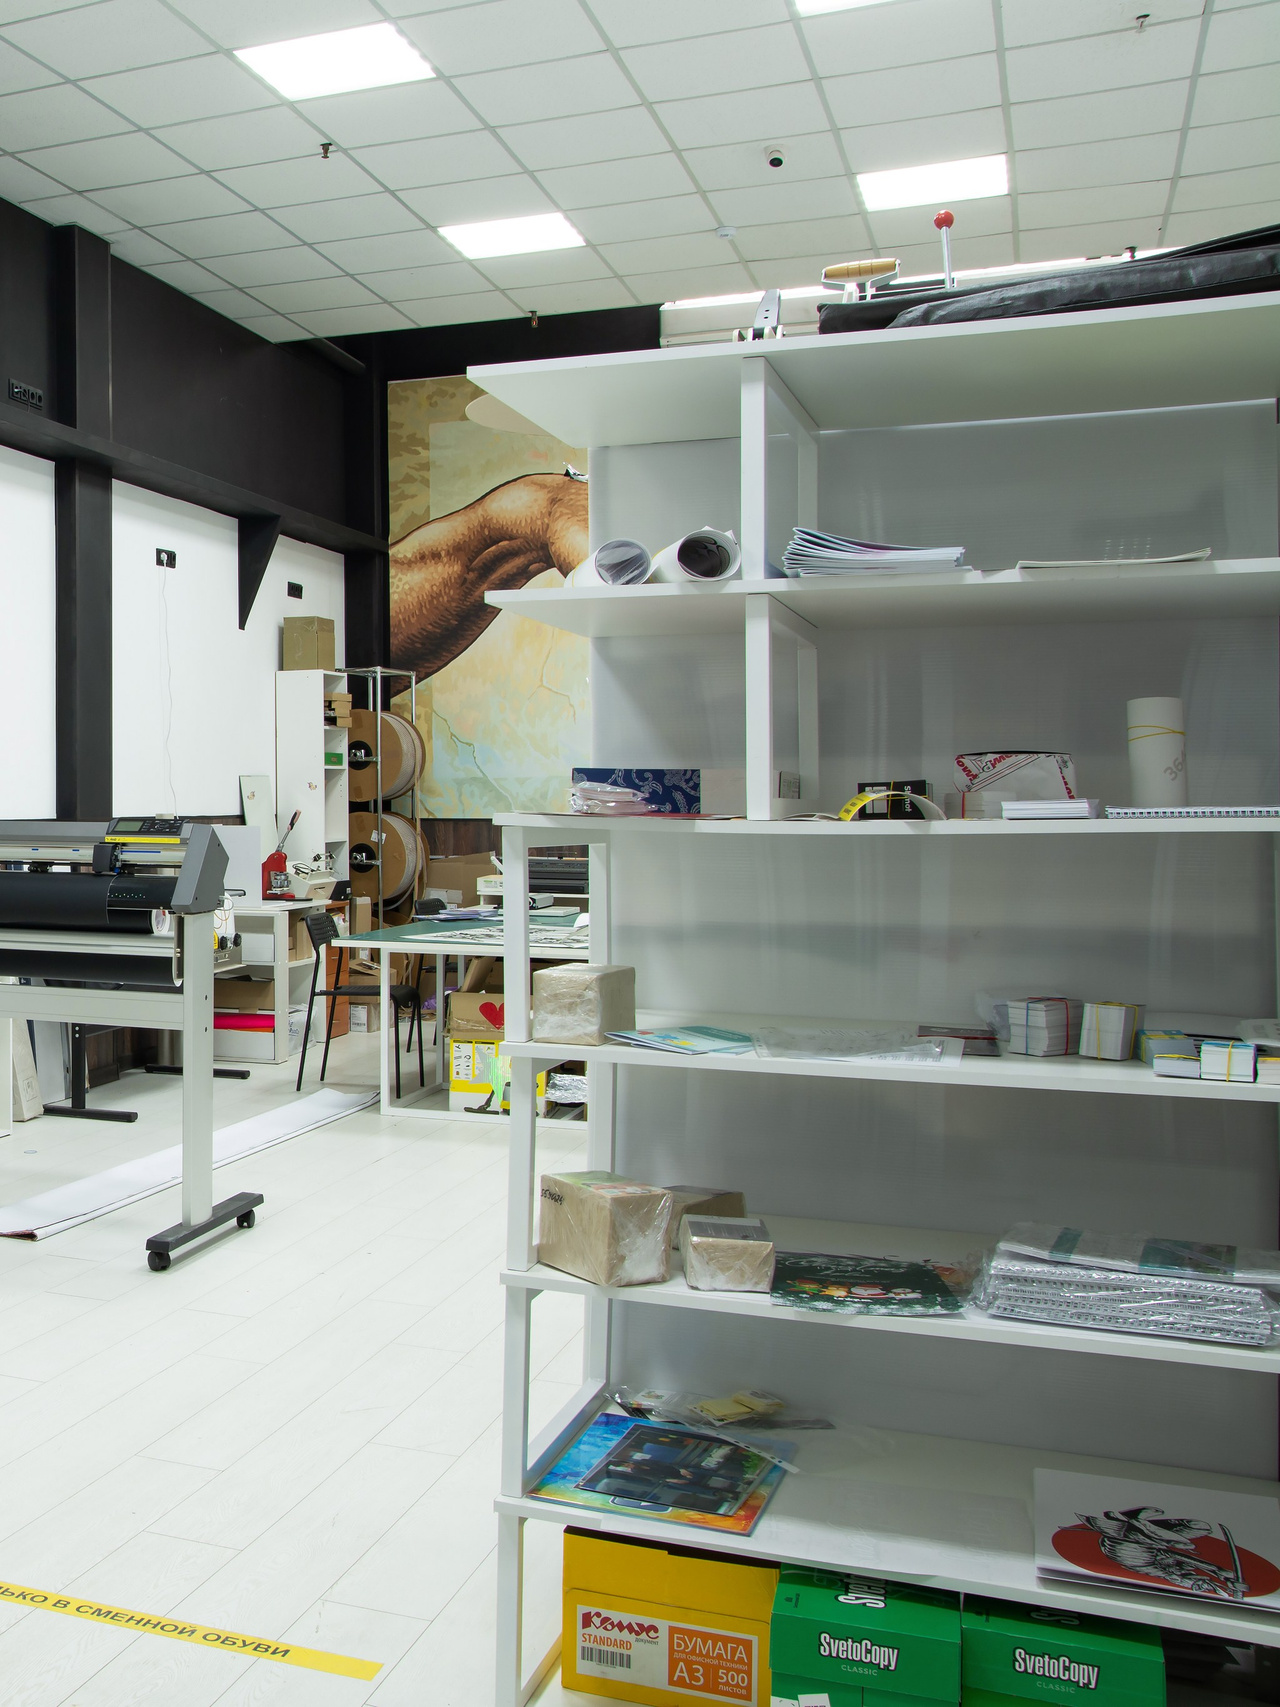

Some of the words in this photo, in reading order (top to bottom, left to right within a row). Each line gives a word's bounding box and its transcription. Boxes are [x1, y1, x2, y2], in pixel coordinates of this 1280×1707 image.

[52, 1599, 71, 1609] В
[75, 1604, 197, 1637] СМЕННОЙ
[202, 1632, 291, 1658] ОБУВИ
[582, 1633, 632, 1650] STANDARD
[634, 1637, 659, 1646] документ
[673, 1633, 748, 1663] БУМАГА
[673, 1651, 687, 1660] ДЛЯ
[687, 1653, 719, 1665] ОФИСНОЙ
[719, 1660, 748, 1671] ТЕХНИКИ
[820, 1632, 899, 1671] SvetoCopy
[718, 1669, 748, 1687] 500
[841, 1664, 878, 1676] CLASSIC
[1014, 1648, 1099, 1689] SvetoCopy
[1036, 1681, 1076, 1694] CLASSIC
